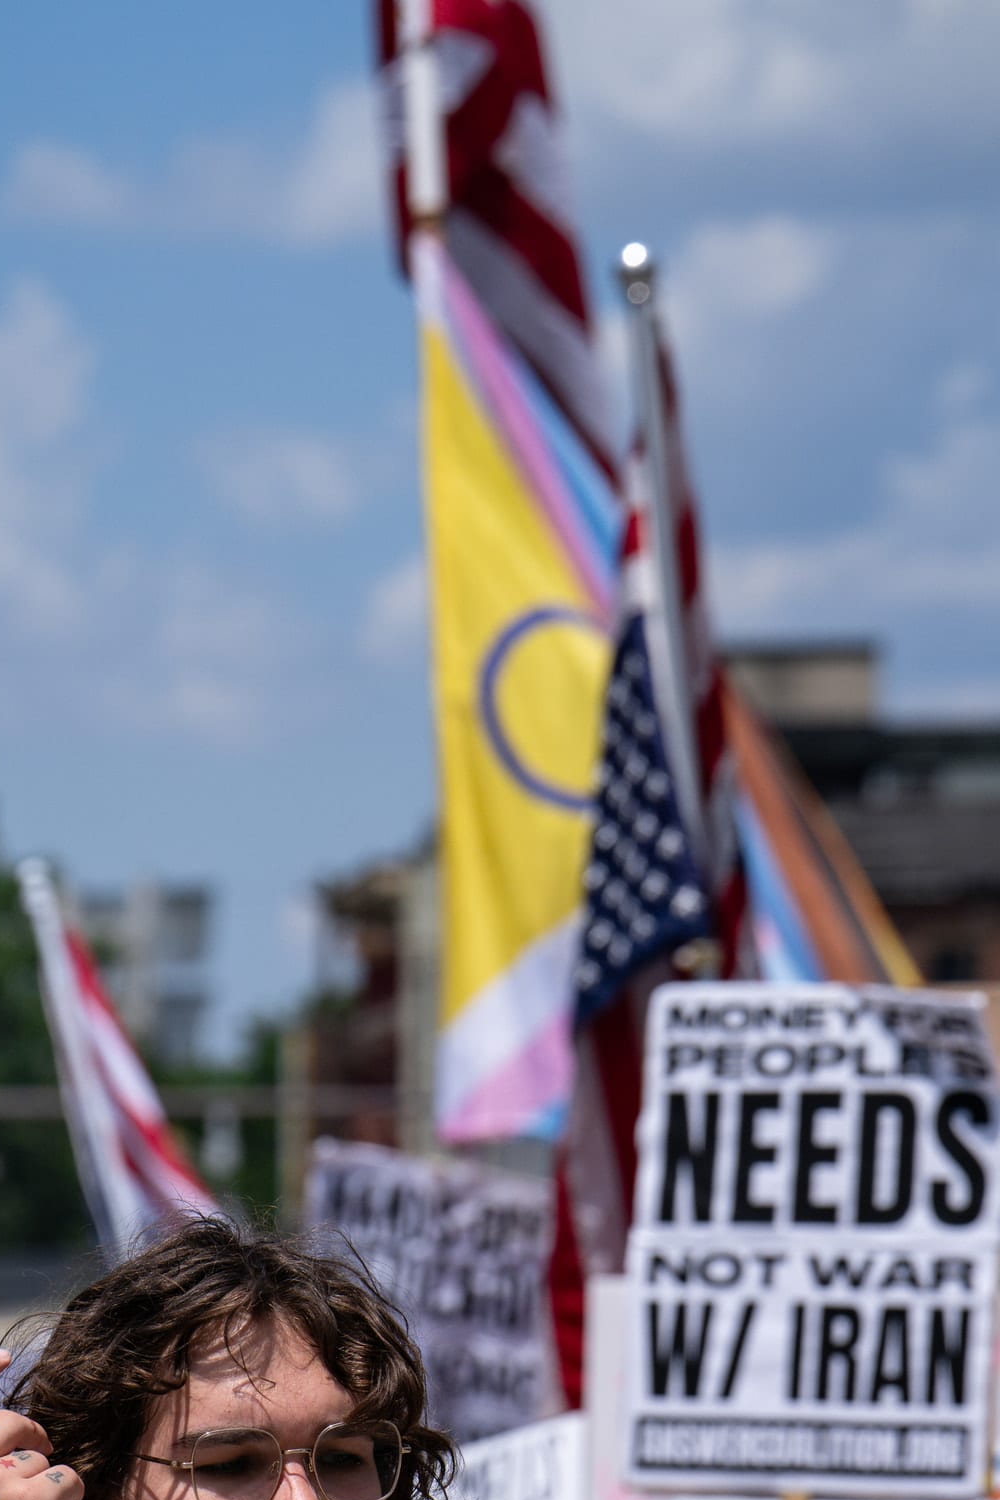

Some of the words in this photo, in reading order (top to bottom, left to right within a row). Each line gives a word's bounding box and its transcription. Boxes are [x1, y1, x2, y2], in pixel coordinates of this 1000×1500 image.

[668, 1003, 866, 1031] MONEY
[658, 1089, 991, 1226] NEEDS
[648, 1252, 785, 1290] NOT
[806, 1255, 976, 1292] WAR
[647, 1301, 755, 1400] W/
[789, 1304, 971, 1406] IRAN
